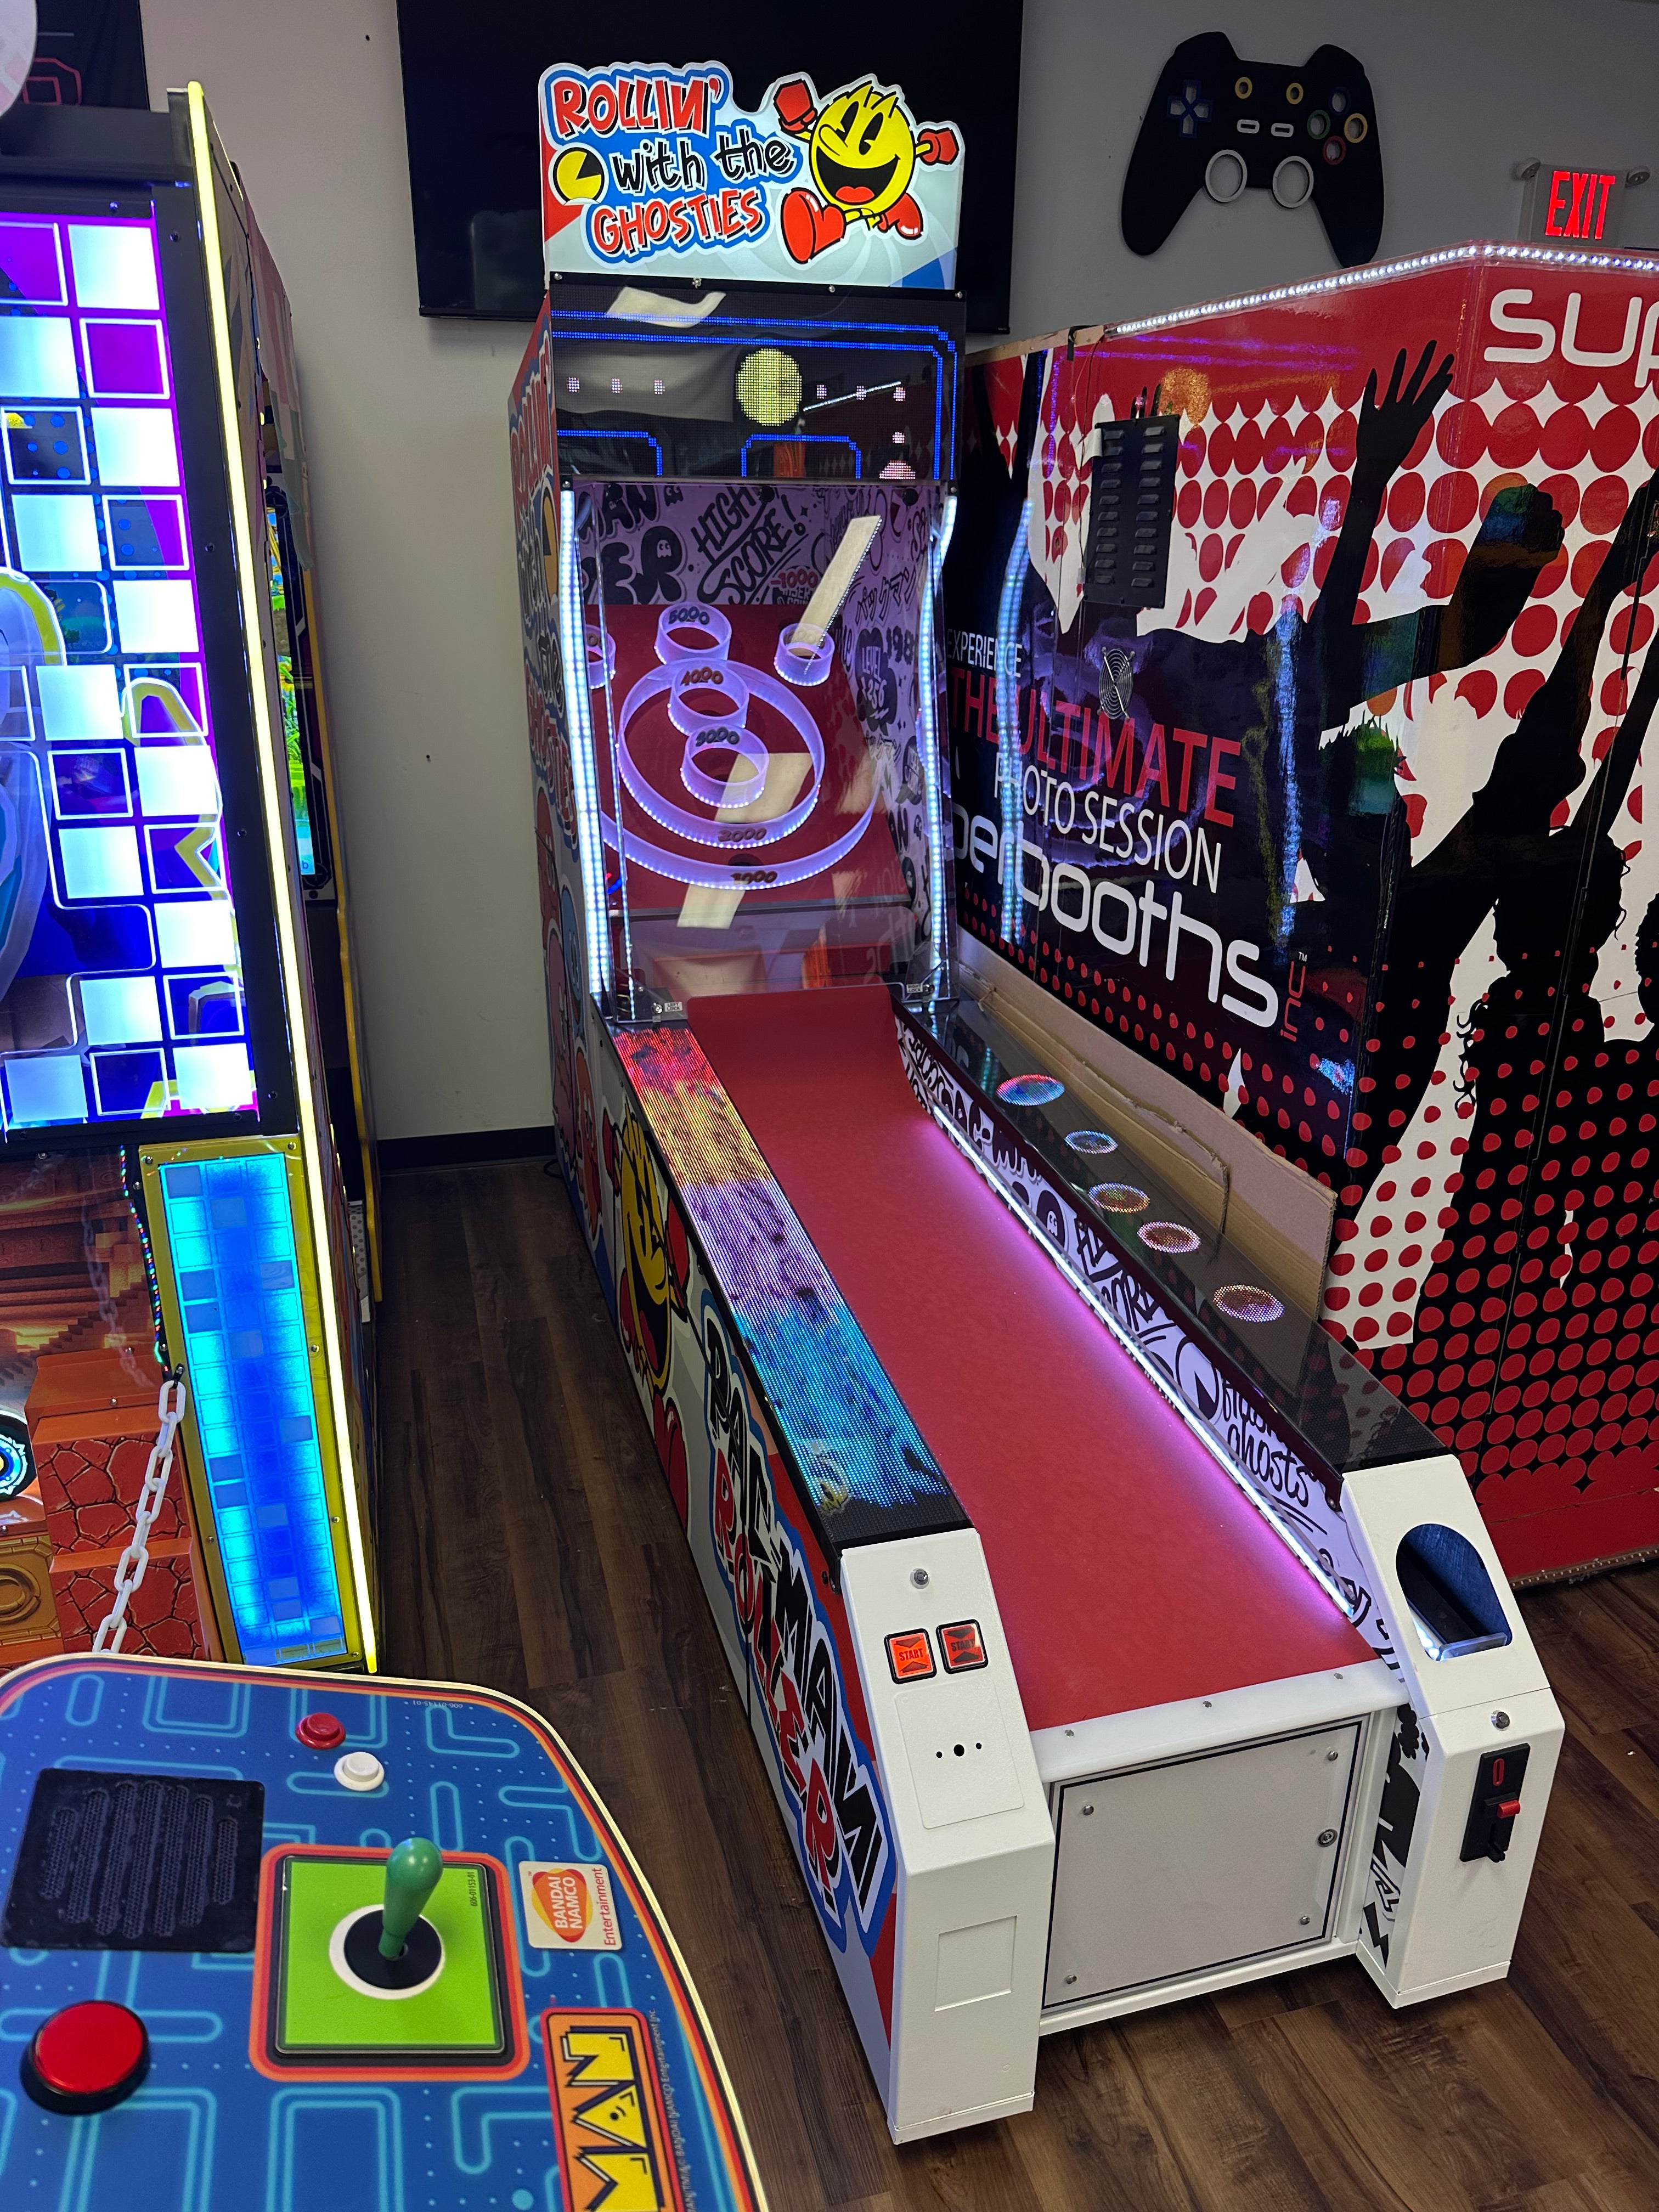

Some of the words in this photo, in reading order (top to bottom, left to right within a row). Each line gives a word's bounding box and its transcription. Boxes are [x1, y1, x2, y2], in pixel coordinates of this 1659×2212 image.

[554, 77, 723, 141] ROLLIN'
[612, 140, 706, 194] with
[715, 128, 794, 181] the
[594, 188, 764, 256] GHOSTIES
[1545, 171, 1615, 240] EXIT
[668, 606, 710, 625] 5000
[681, 666, 724, 686] 4000
[948, 666, 1000, 746] THE
[1014, 683, 1242, 827] ULTIMATE
[718, 827, 768, 843] 2000
[994, 752, 1075, 834] PHOTO
[1085, 791, 1222, 894] SESSION
[730, 870, 778, 885] 1000
[705, 1314, 883, 1920] PAC-MAN
[950, 1638, 975, 1652] START
[714, 1446, 840, 1914] ROLLER
[899, 1648, 923, 1662] START
[467, 1871, 478, 1907] 606-01153-01
[548, 1876, 568, 1929] BANDAI
[562, 1876, 583, 1929] NAMCO
[591, 1867, 616, 1946] Entertainment
